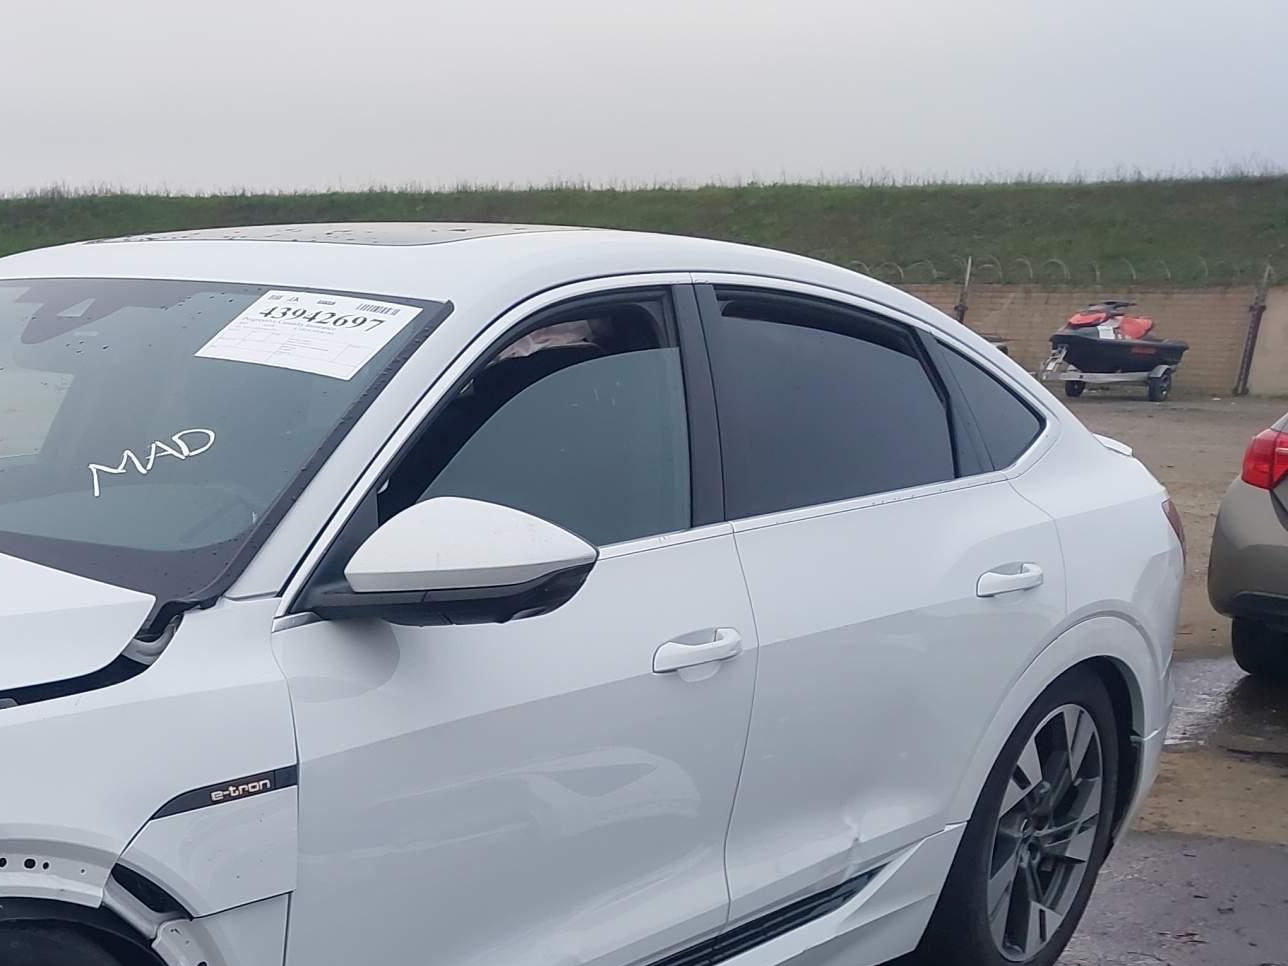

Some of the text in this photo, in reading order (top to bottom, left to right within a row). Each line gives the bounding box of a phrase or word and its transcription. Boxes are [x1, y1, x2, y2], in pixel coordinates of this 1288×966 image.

[259, 305, 386, 332] 43942697
[88, 428, 216, 497] MAD
[210, 778, 271, 801] e-tron
